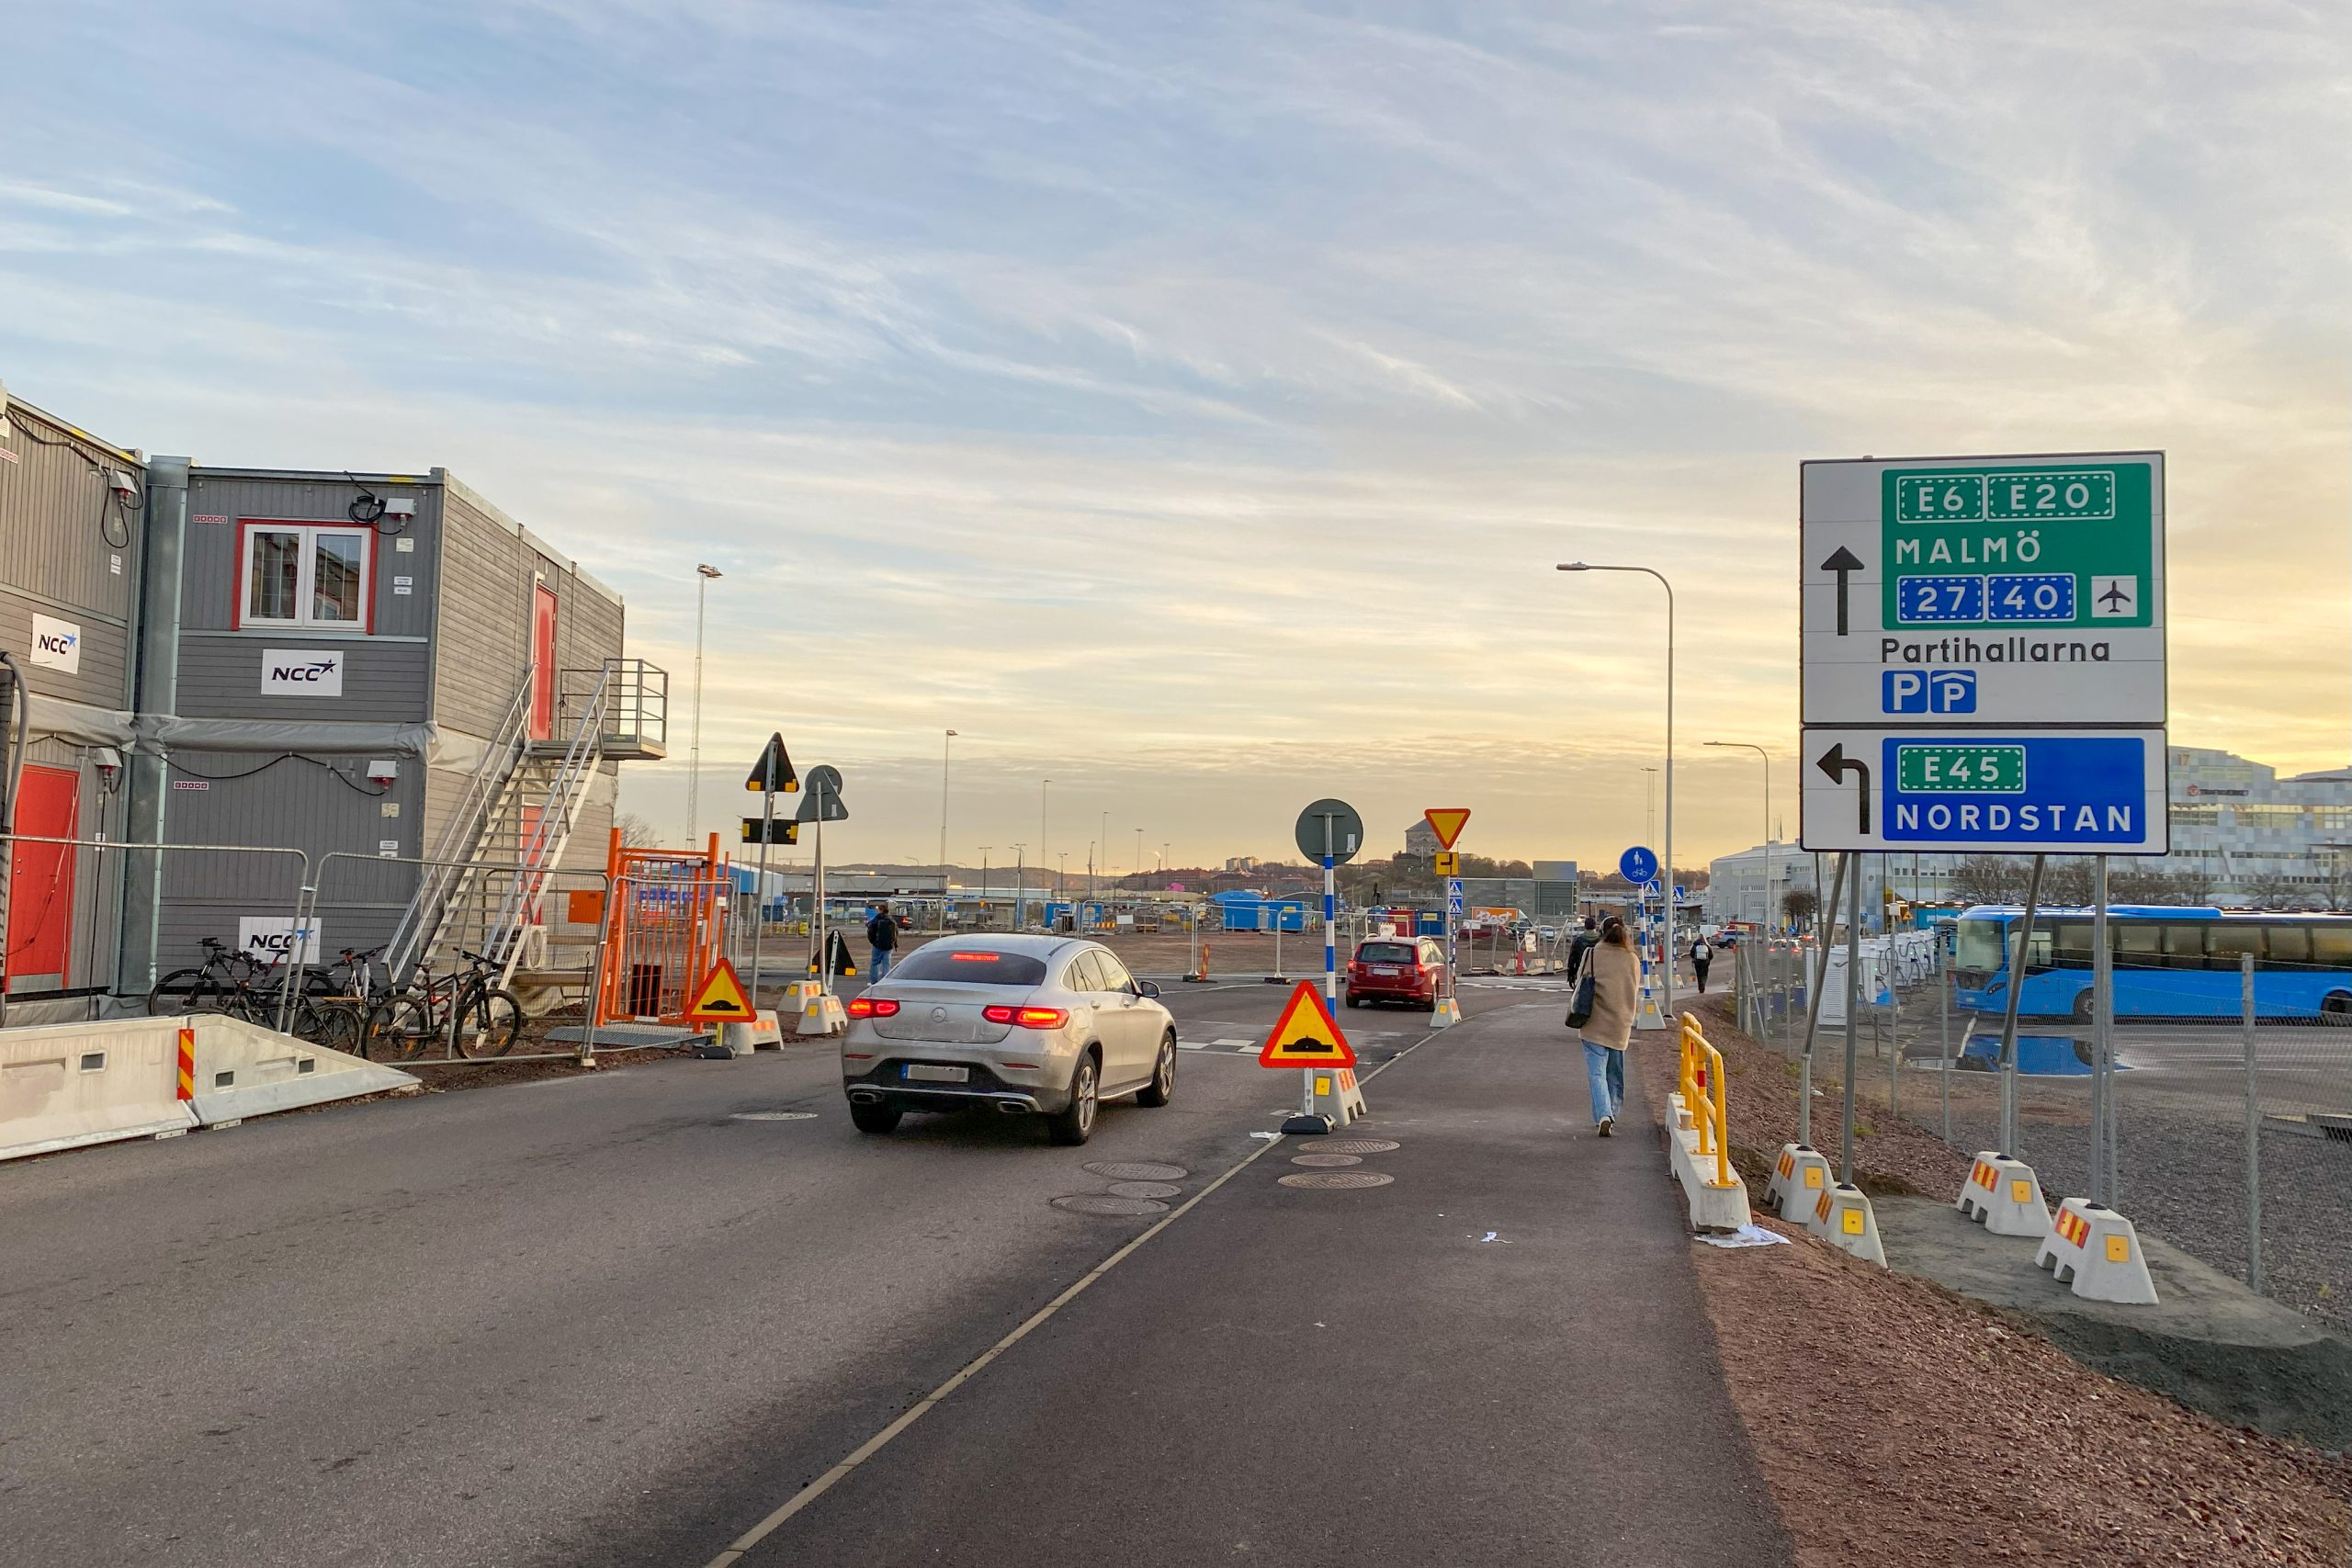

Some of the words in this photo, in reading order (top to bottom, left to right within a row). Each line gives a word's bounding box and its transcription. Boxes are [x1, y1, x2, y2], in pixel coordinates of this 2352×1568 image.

[1918, 486, 1964, 512] E6
[2010, 483, 2089, 510] E20
[1895, 530, 2041, 564] MALMÖ
[1917, 586, 1966, 613] 27
[2003, 585, 2058, 610] 40
[38, 634, 68, 655] NCC
[1882, 637, 2109, 663] Partihallarna
[271, 667, 321, 681] NCC
[1893, 673, 1921, 711] P
[1943, 682, 1966, 712] P
[1924, 756, 2000, 782] E45
[1895, 804, 2132, 832] NORDSTAN
[249, 934, 298, 949] NCC
